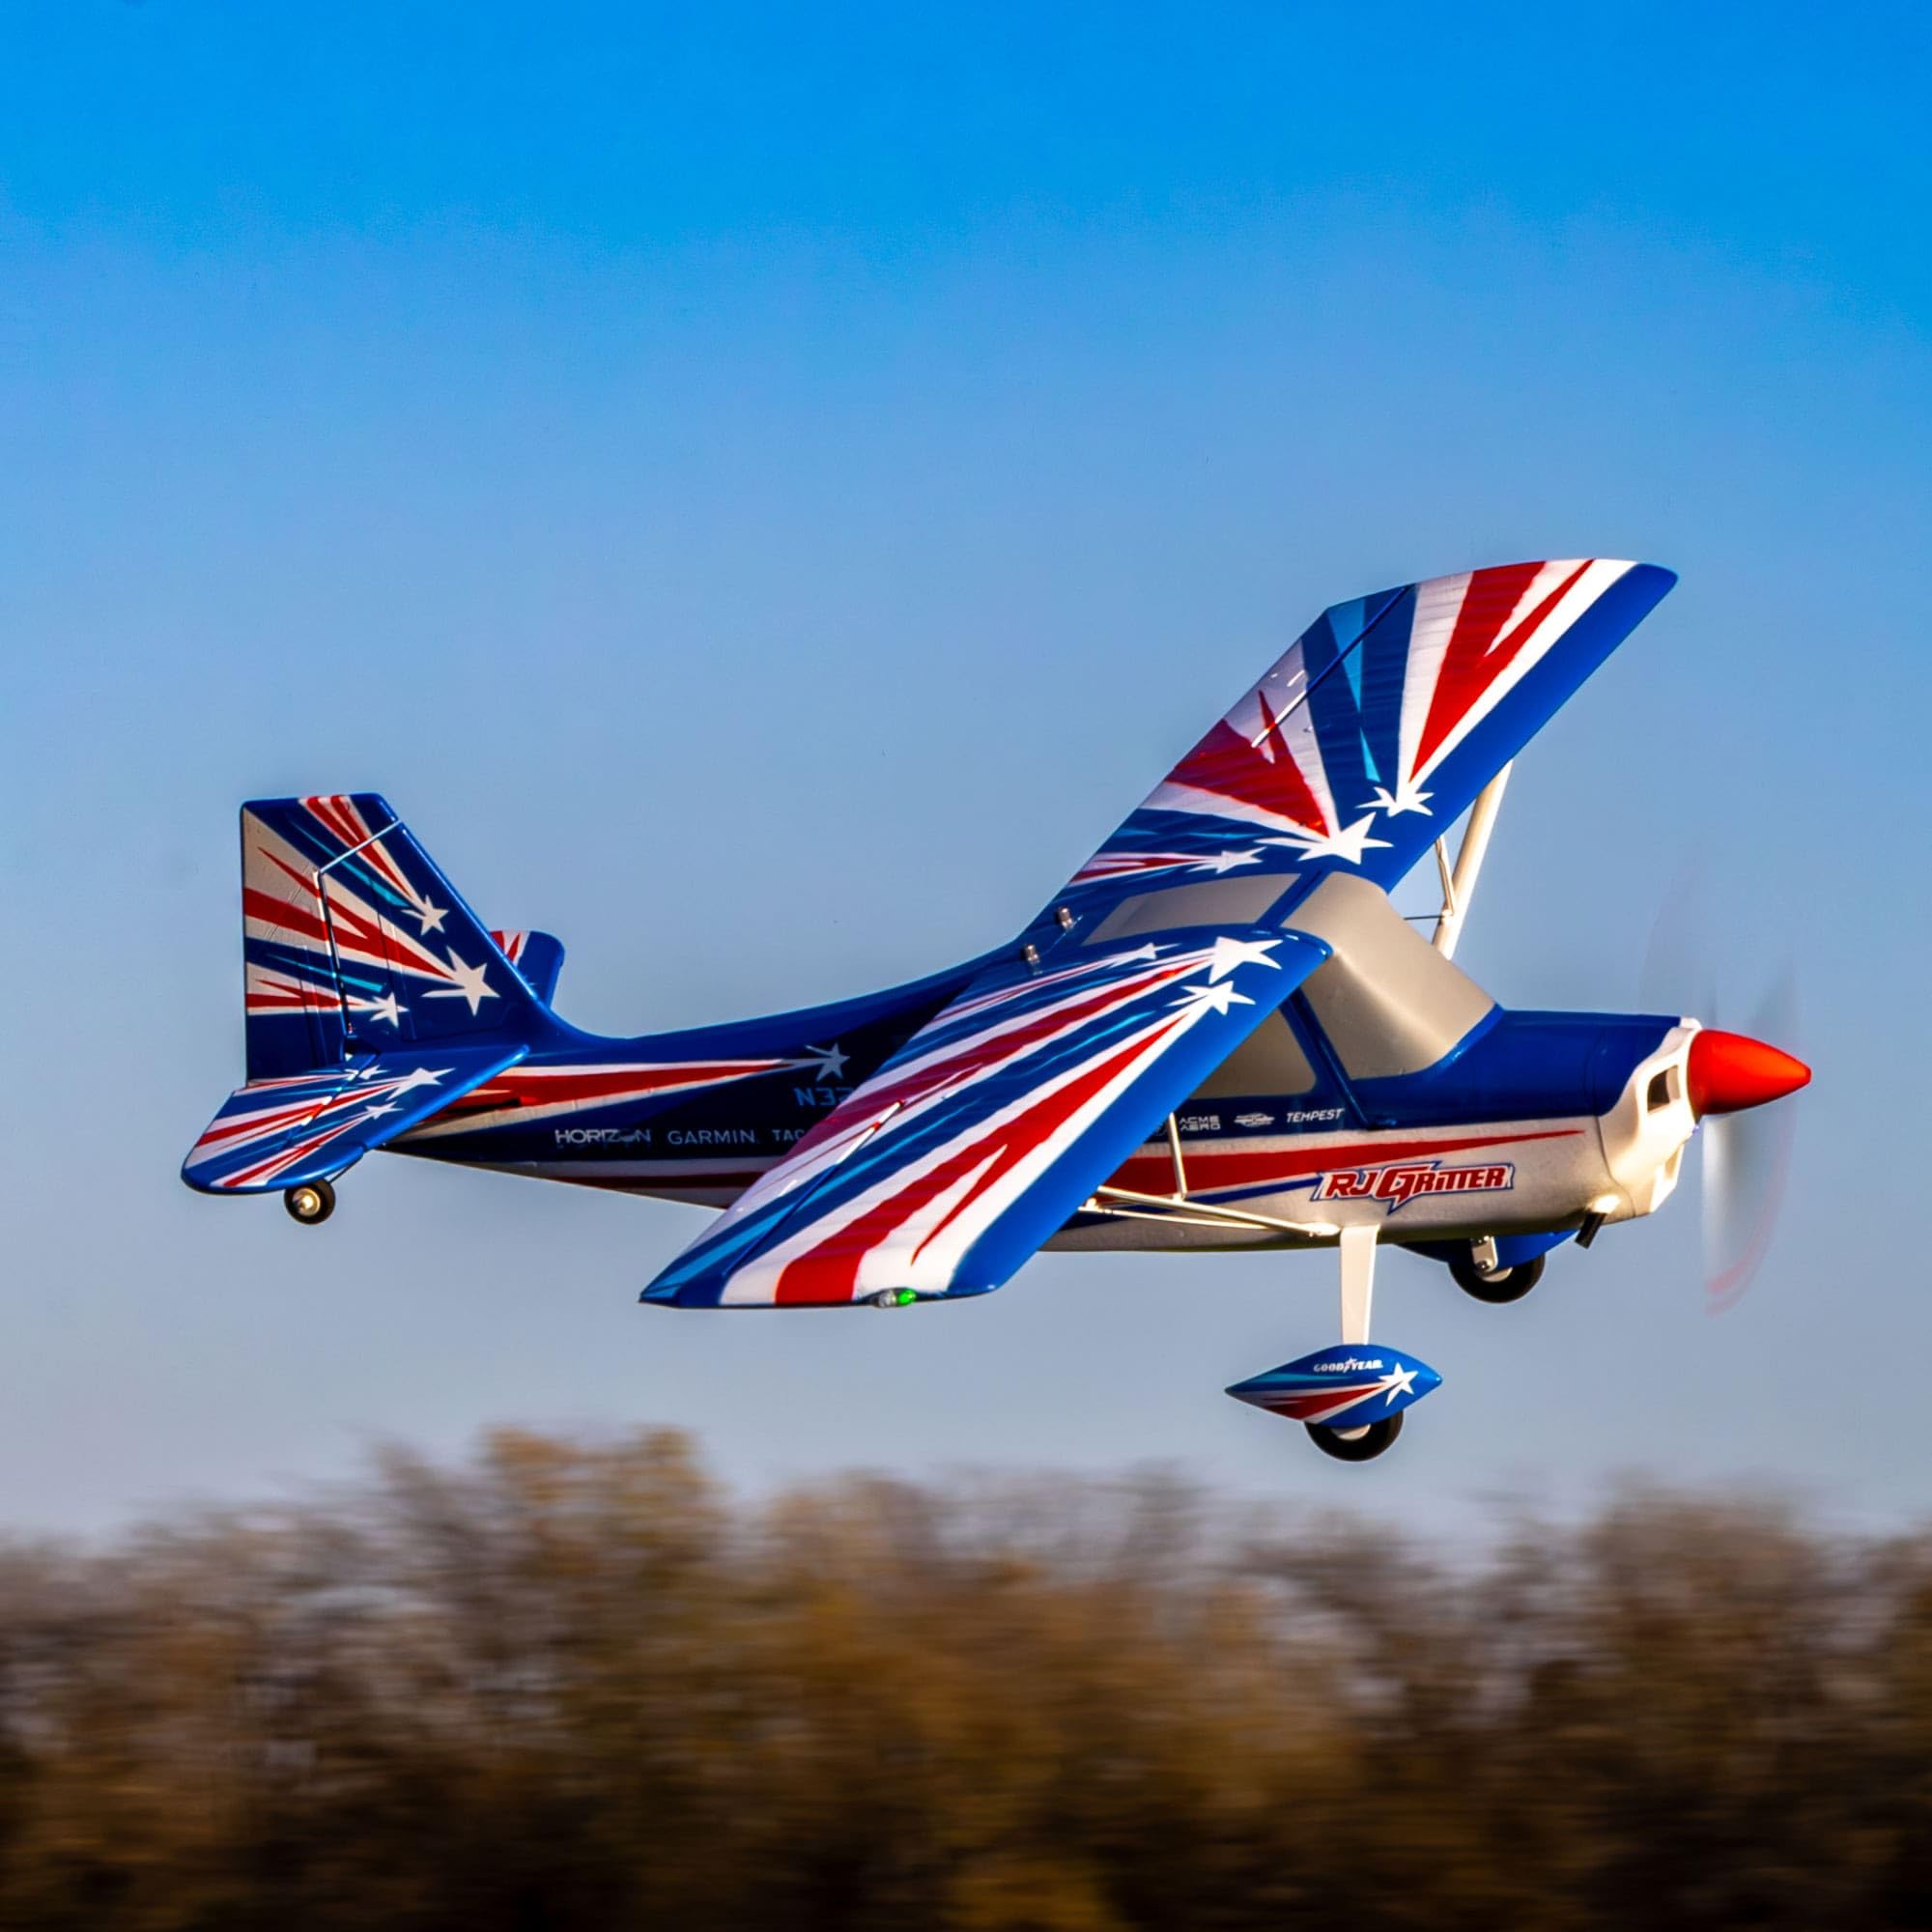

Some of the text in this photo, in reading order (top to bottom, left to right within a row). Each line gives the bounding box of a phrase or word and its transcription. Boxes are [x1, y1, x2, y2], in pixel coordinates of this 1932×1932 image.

[1179, 1115, 1219, 1123] ACME
[1287, 1109, 1344, 1122] TEMPEST
[1179, 1122, 1221, 1131] AERO
[554, 1128, 652, 1144] HORIZON
[668, 1128, 756, 1145] GARMIN
